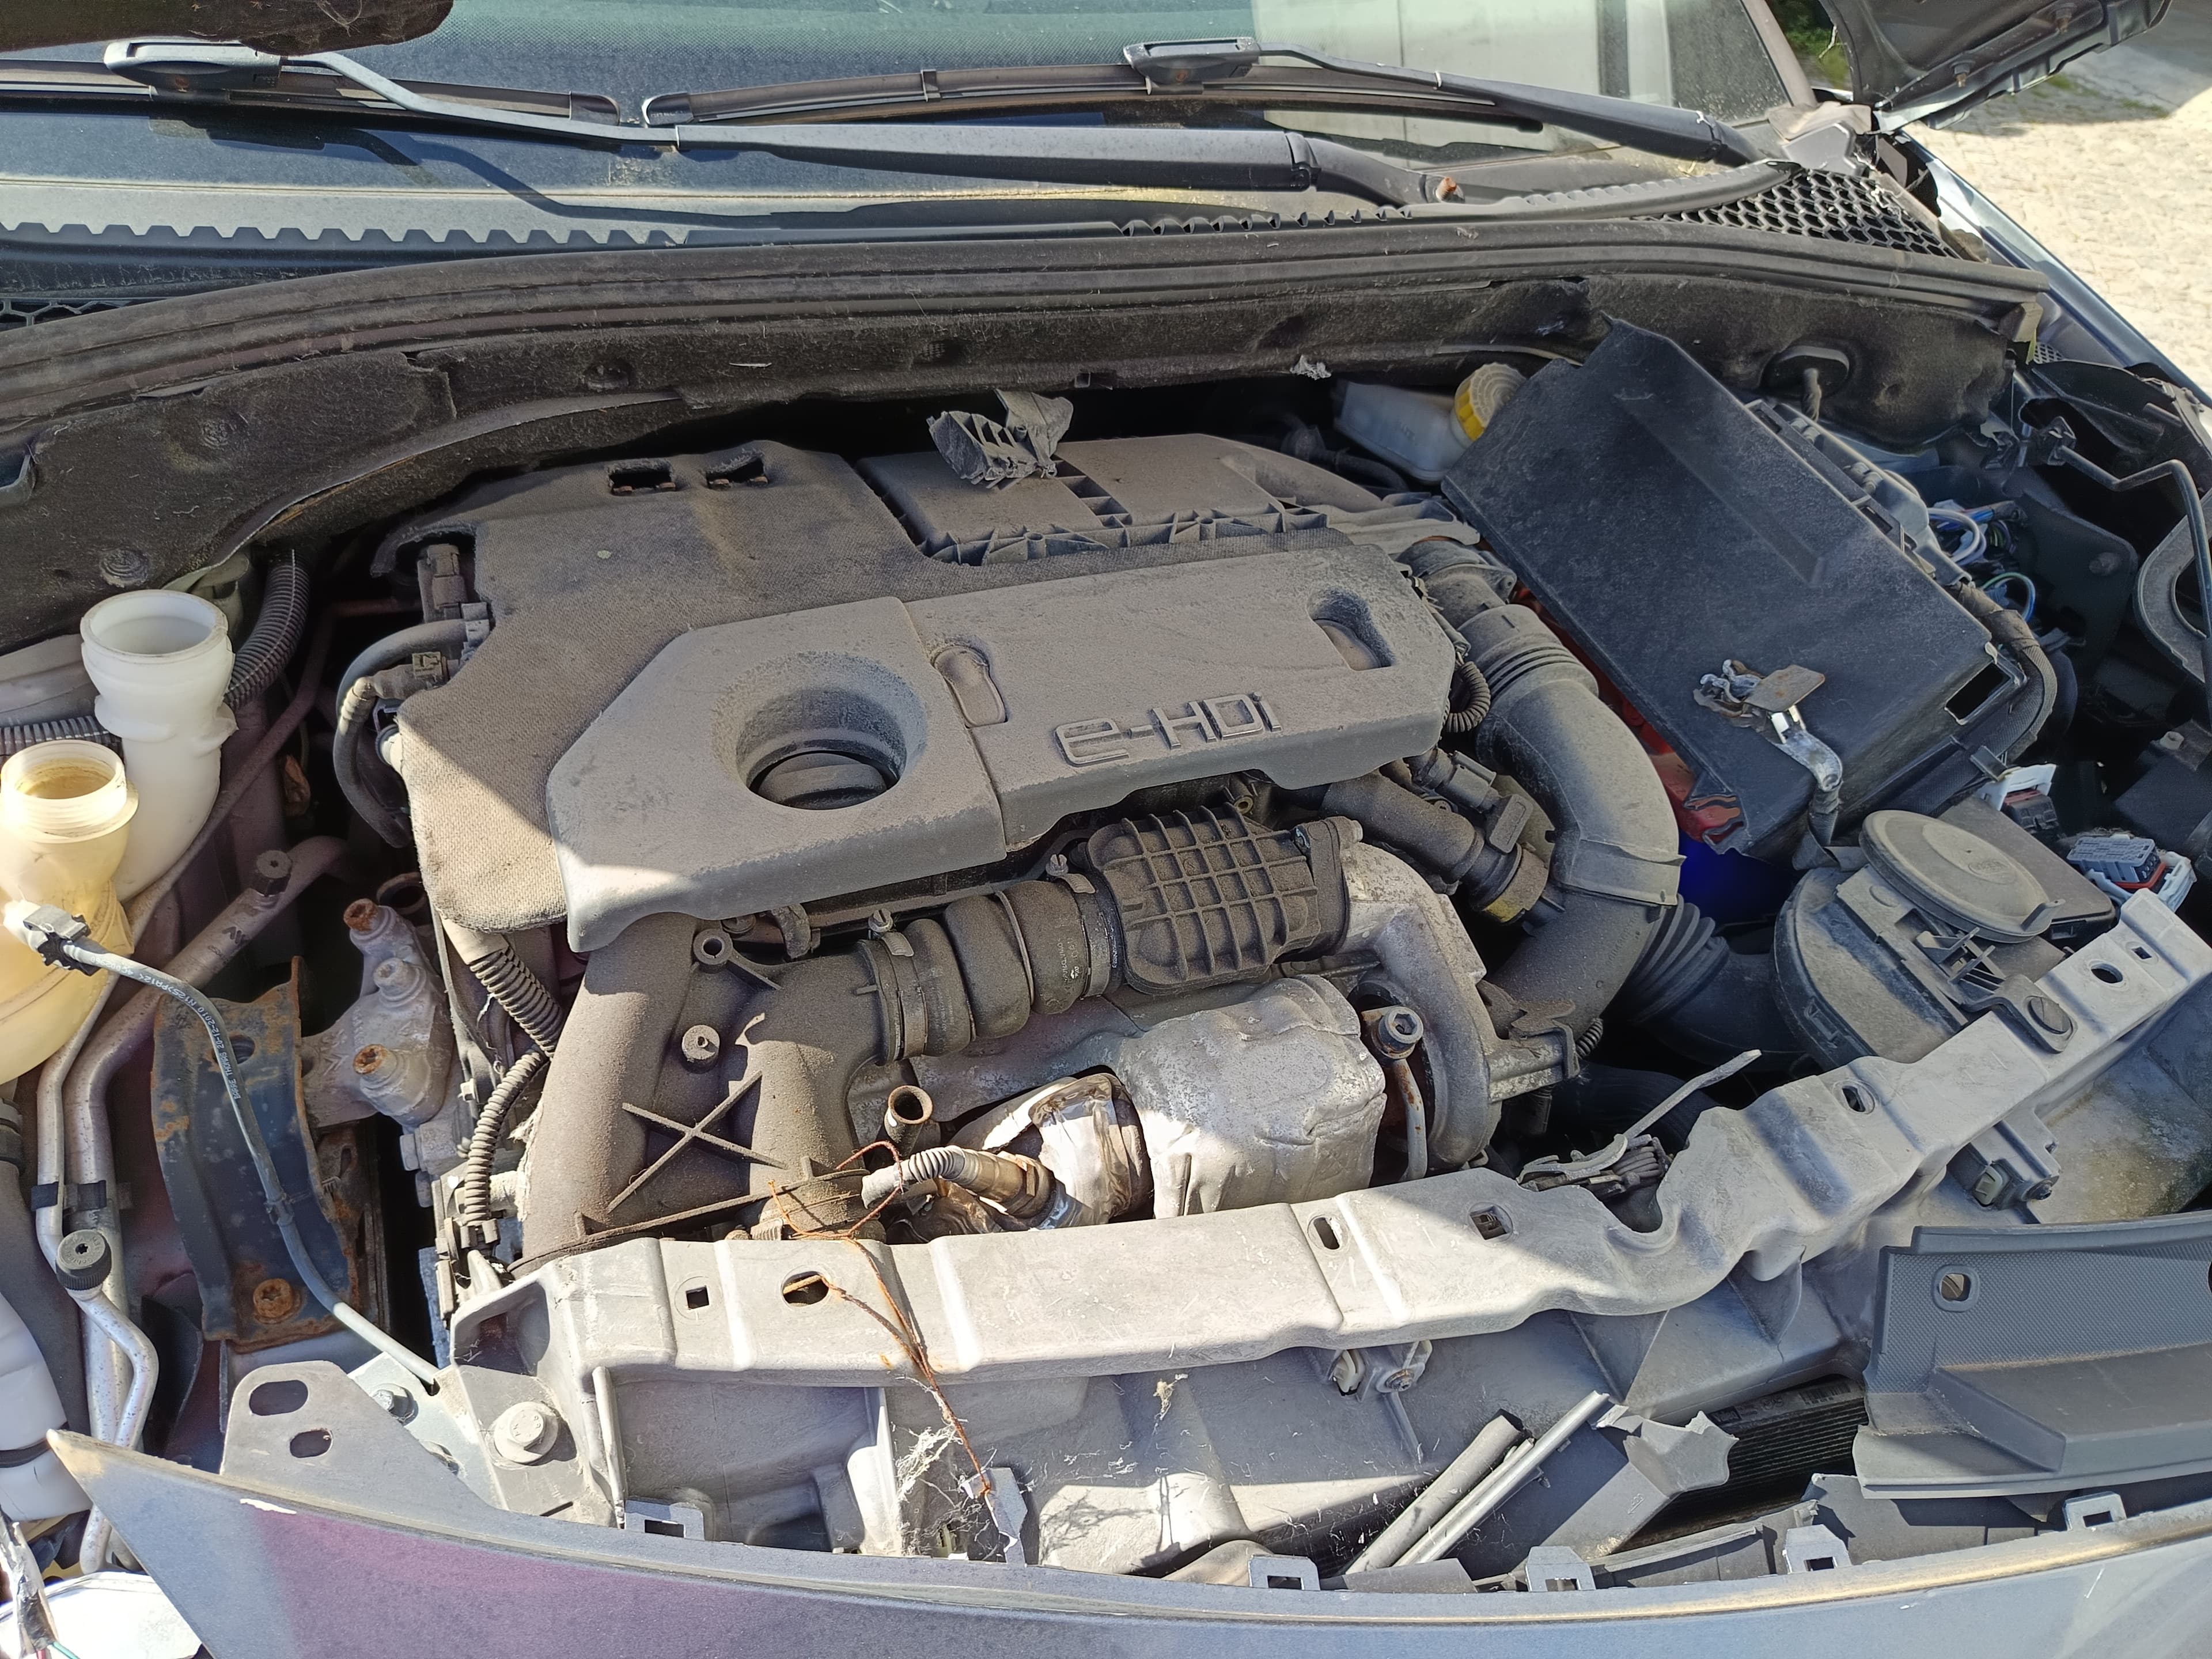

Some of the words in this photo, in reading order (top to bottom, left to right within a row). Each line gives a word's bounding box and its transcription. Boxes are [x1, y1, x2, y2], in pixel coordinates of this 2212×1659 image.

[1055, 691, 1282, 768] e-HDi
[198, 1006, 225, 1050] 20-12-2010
[219, 1051, 233, 1077] THOMAS
[229, 1078, 241, 1100] BARRE
